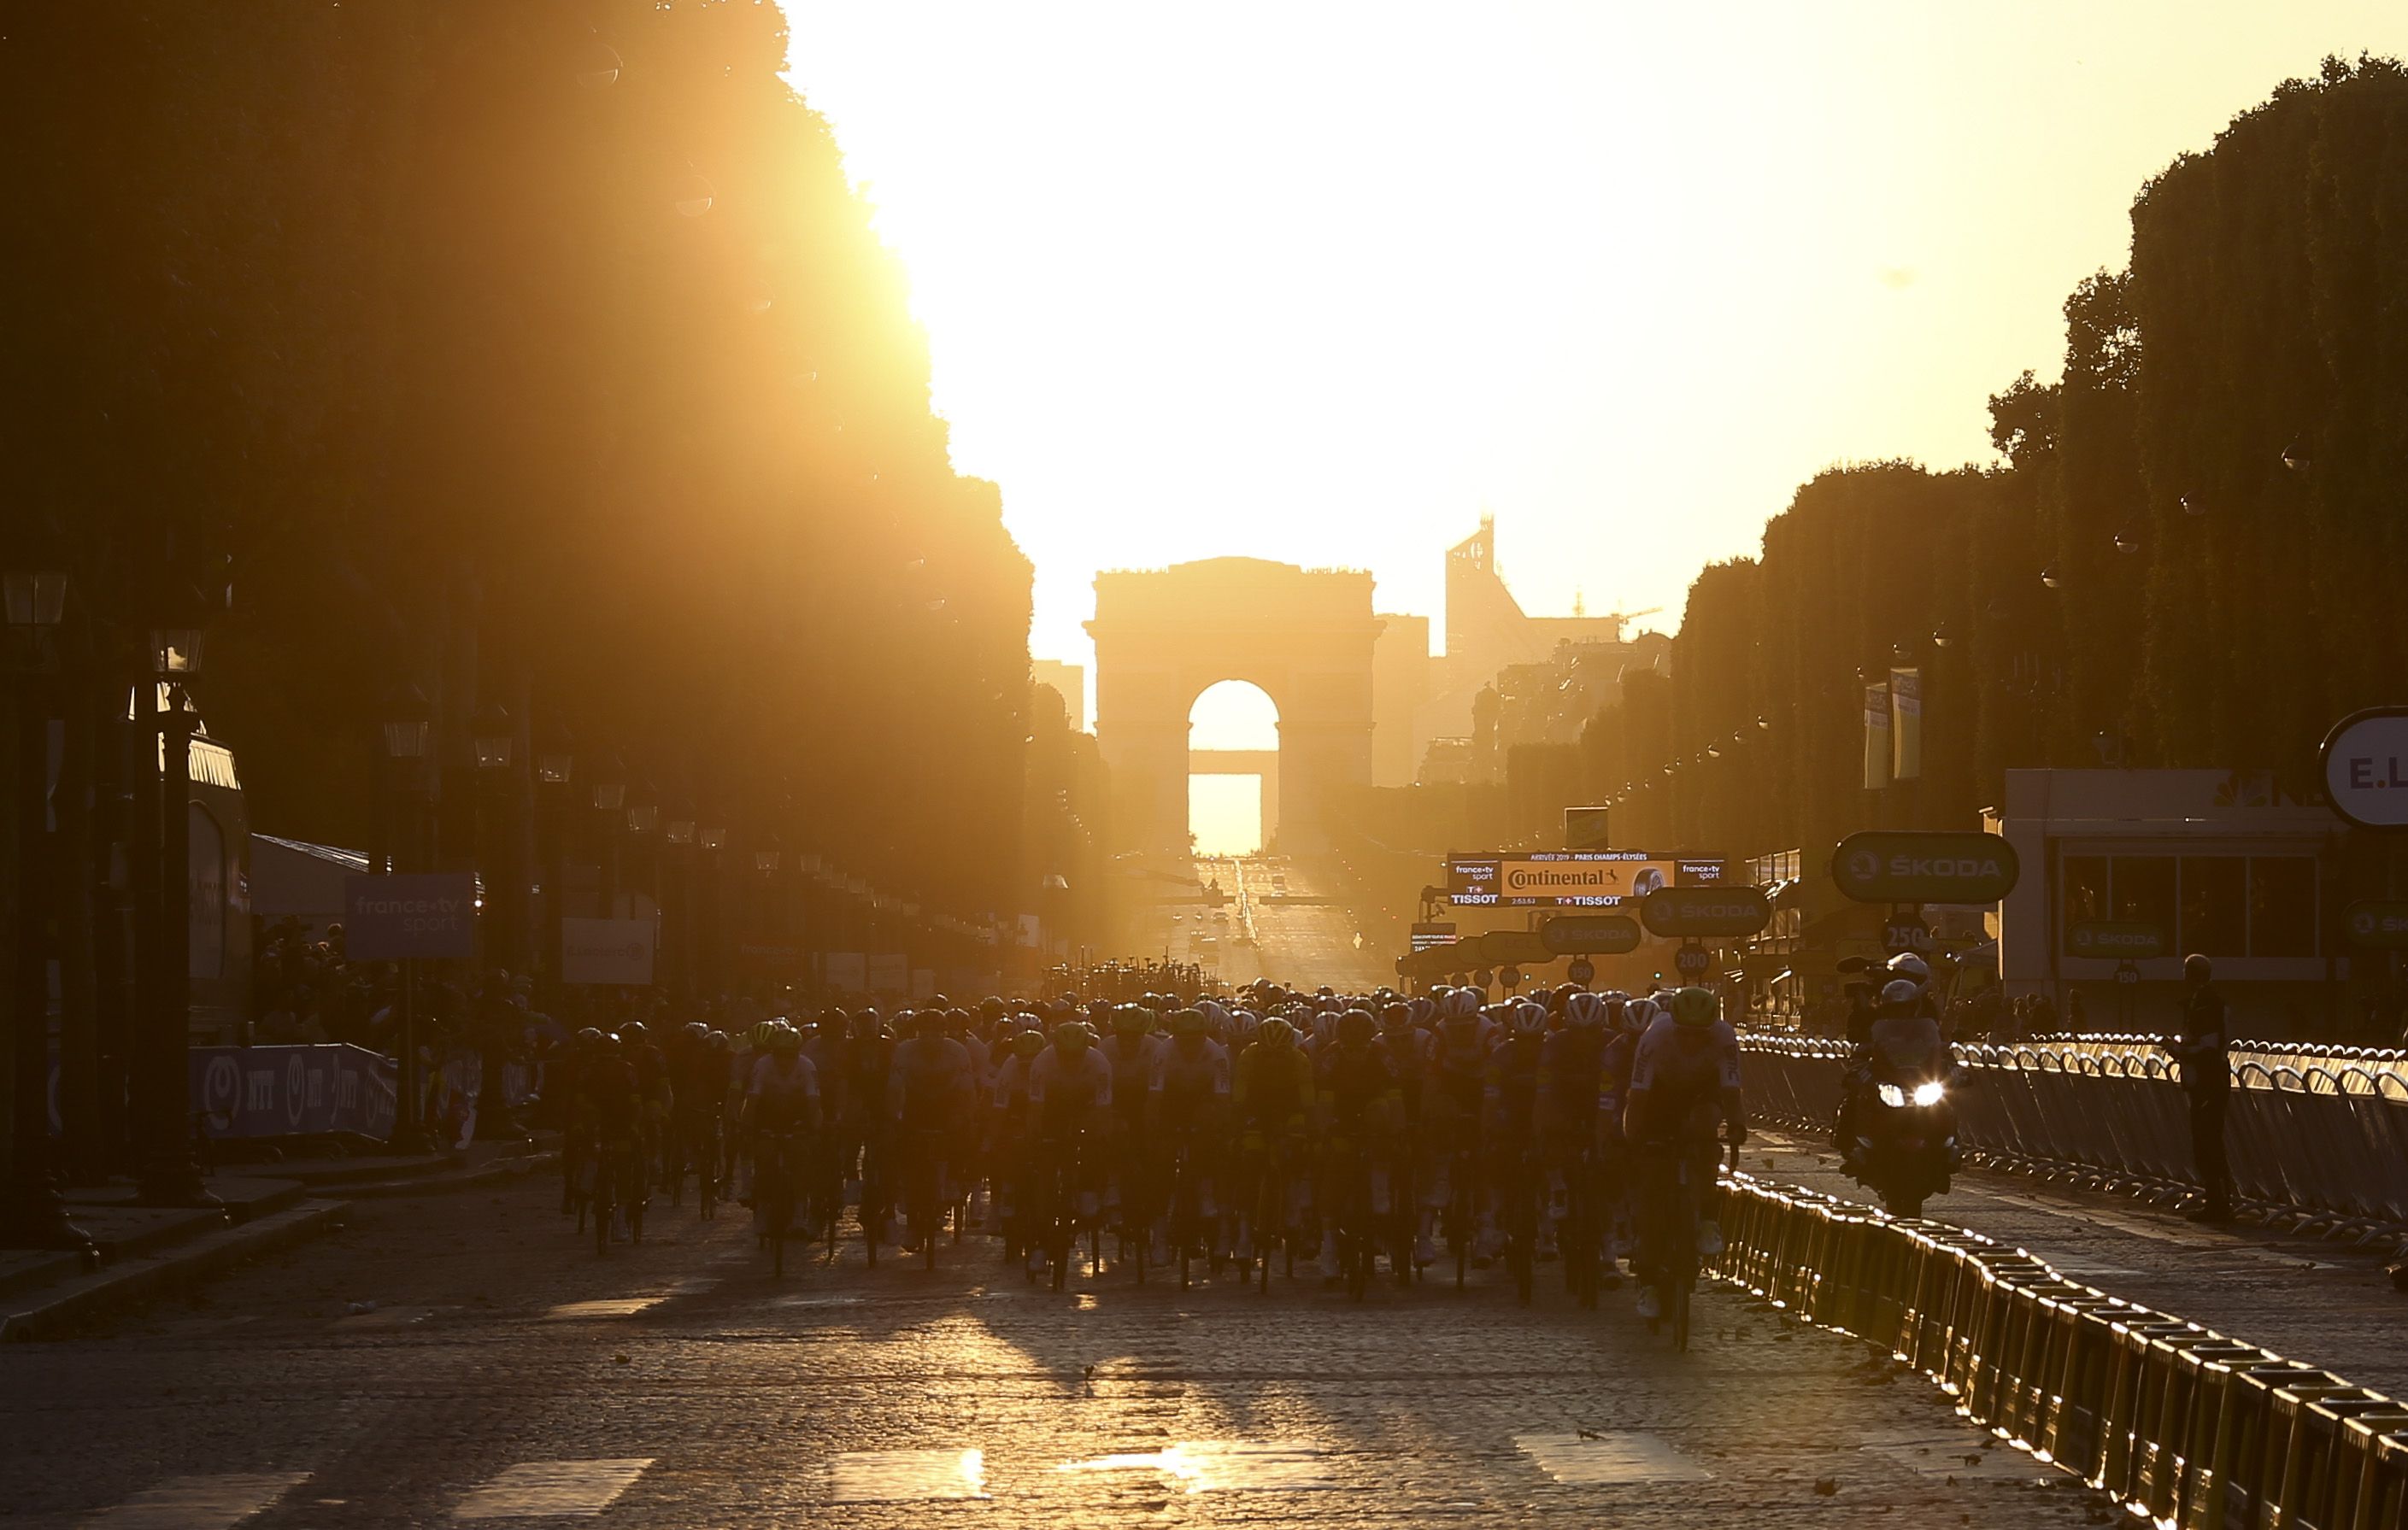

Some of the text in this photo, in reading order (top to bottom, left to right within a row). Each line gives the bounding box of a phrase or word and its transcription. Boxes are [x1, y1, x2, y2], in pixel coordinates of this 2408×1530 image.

[1575, 853, 1593, 861] PARIS
[1889, 854, 2001, 876] ŠKODA
[1508, 870, 1603, 889] Continental
[1451, 894, 1498, 904] TISSOT
[1573, 896, 1621, 906] TISSOT
[402, 915, 459, 936] sport
[1887, 926, 1924, 947] 250
[1677, 953, 1707, 968] 200
[2118, 971, 2137, 983] 150
[245, 1070, 273, 1111] NTT
